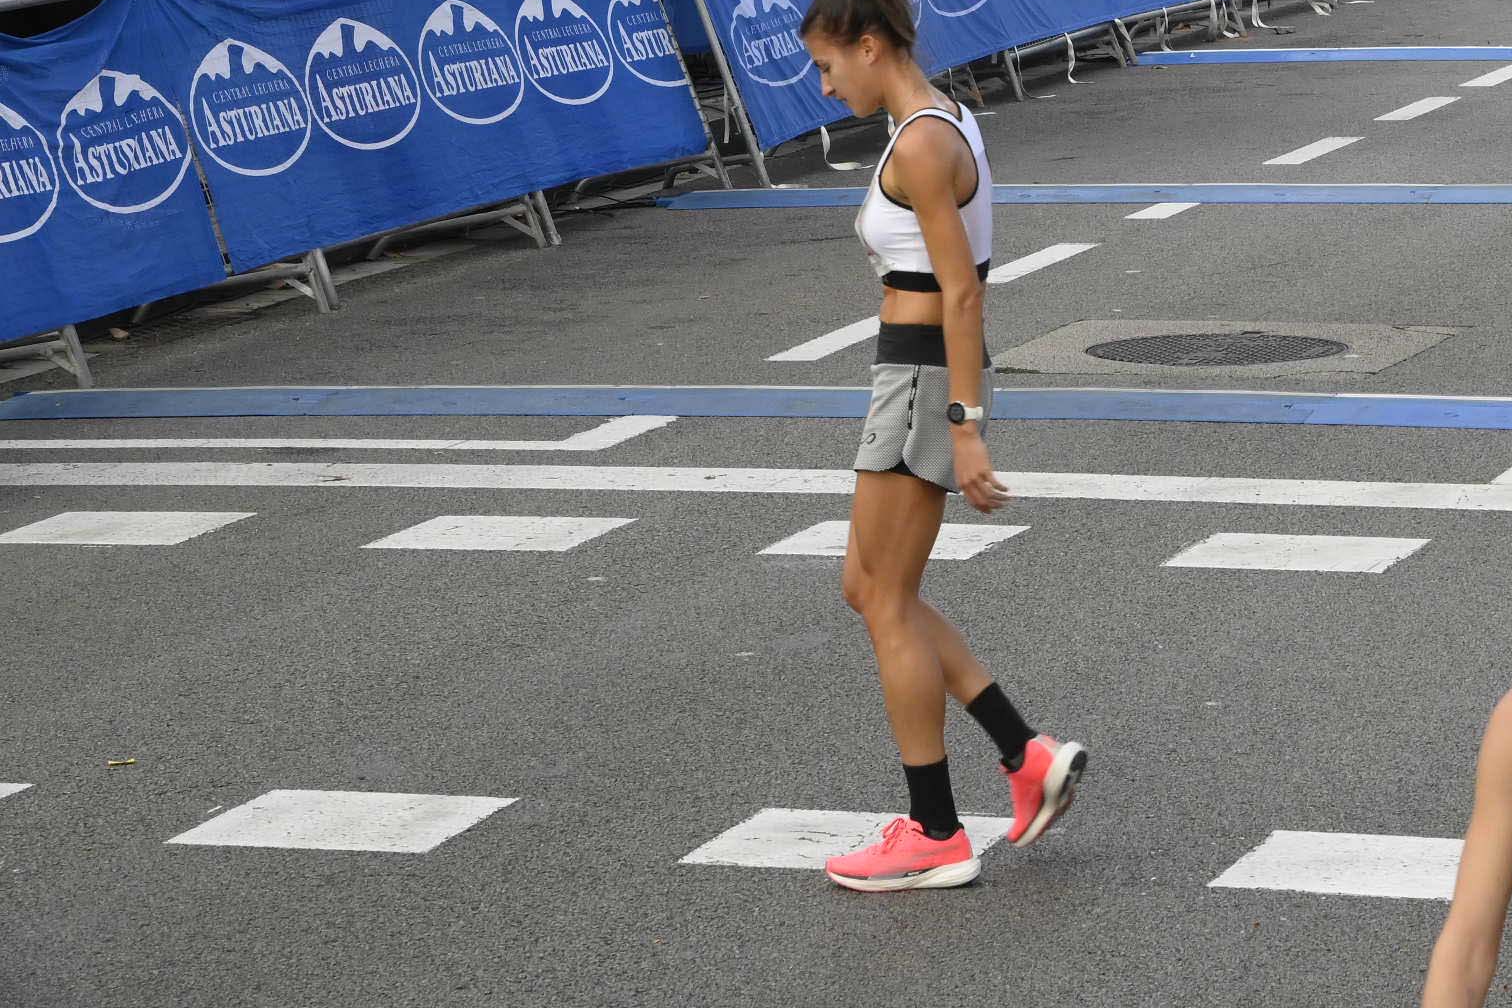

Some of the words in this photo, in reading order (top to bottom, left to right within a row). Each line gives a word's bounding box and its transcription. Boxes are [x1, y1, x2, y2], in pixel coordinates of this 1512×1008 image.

[531, 28, 561, 42] CENTRAL
[561, 22, 592, 38] LECHERA
[625, 12, 658, 26] CENTRAL
[438, 42, 471, 58] CENTRAL
[472, 38, 504, 53] LECHERA
[523, 34, 609, 80] ASTURIANA
[326, 63, 363, 81] CENTRAL
[364, 55, 401, 73] LECHERA
[428, 49, 520, 98] ASTURIANA
[212, 85, 252, 104] CENTRAL
[253, 78, 290, 95] LECHERA
[315, 72, 417, 124] ASTURIANA
[201, 96, 307, 149] ASTURIANA
